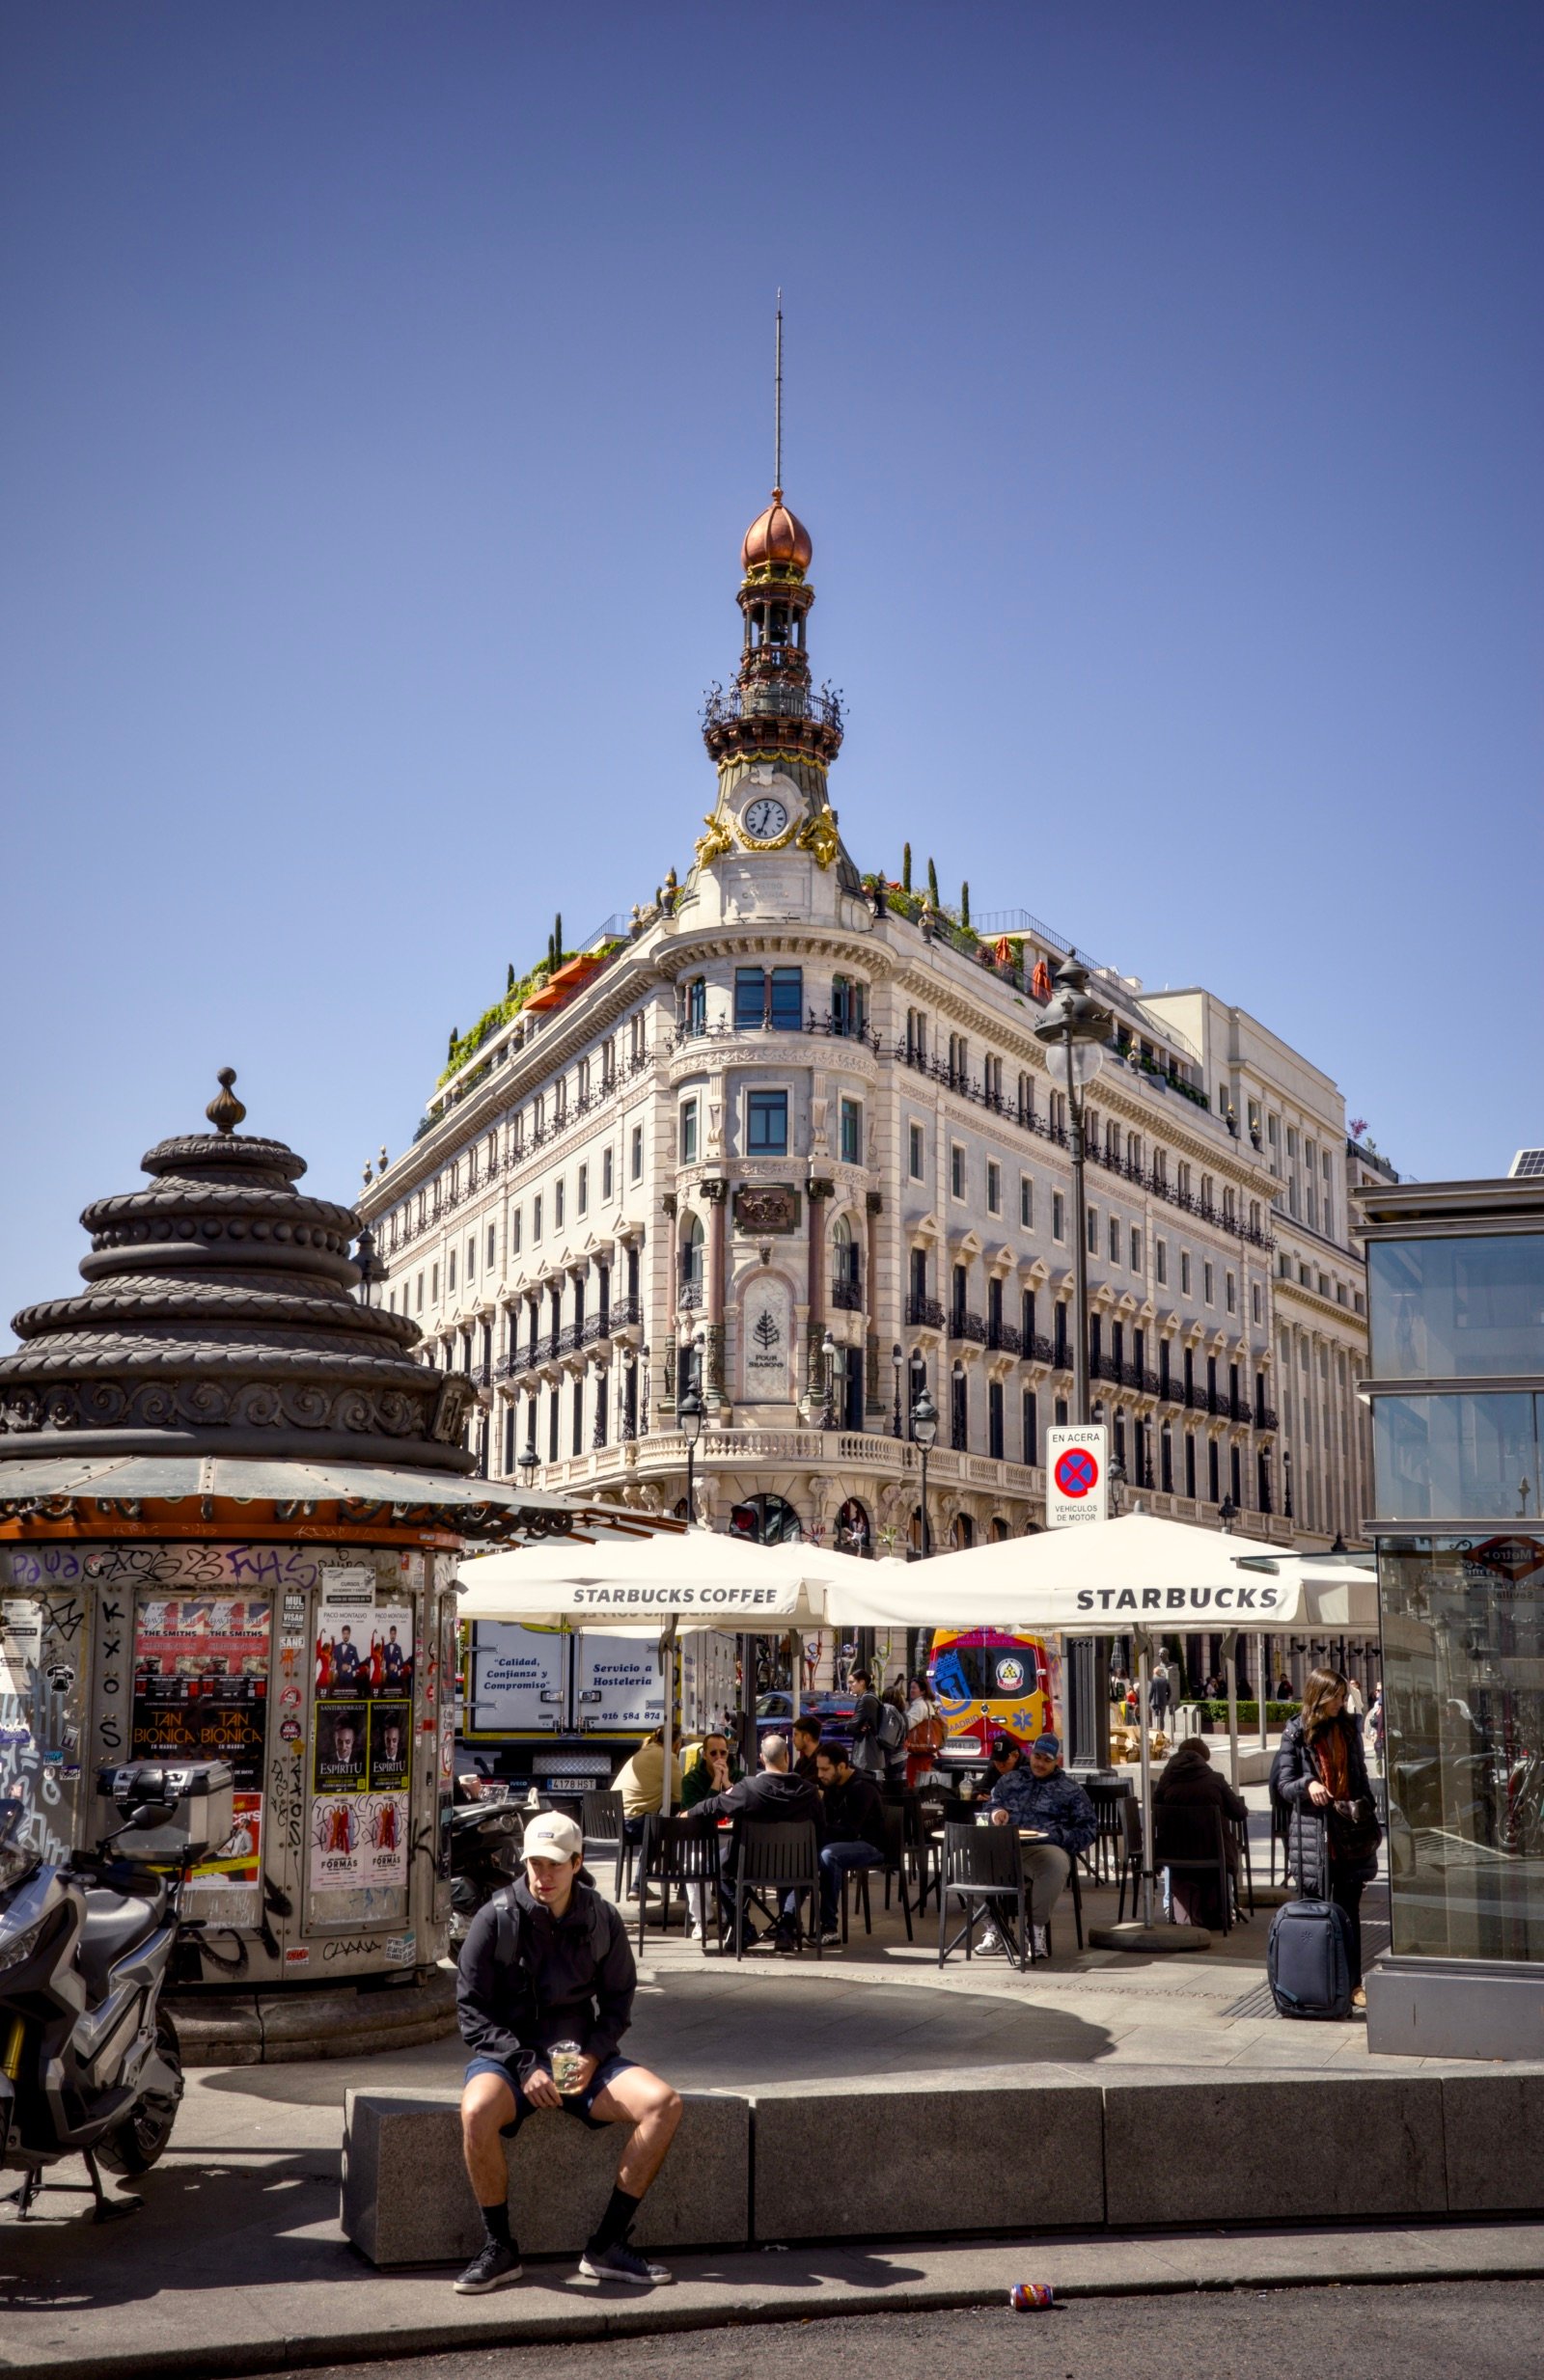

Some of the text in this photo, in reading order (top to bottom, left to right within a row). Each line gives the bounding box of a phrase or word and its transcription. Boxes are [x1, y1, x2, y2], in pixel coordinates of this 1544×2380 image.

[1052, 1433, 1100, 1442] EN ACERA
[1055, 1504, 1098, 1513] VEHÍCULOS
[573, 1588, 778, 1603] STARBUCKS COFFEE
[1076, 1587, 1279, 1611] STARBUCKS
[285, 1596, 305, 1606] MUL
[593, 1663, 640, 1673] Servicio
[486, 1670, 538, 1679] Confianza
[151, 1711, 182, 1727] TAN
[218, 1711, 250, 1727] TAN
[601, 1711, 619, 1720] 916
[622, 1711, 640, 1720] 584
[644, 1711, 660, 1720] 874
[134, 1728, 196, 1743] BIONICA
[201, 1728, 262, 1743] BIONICA
[553, 1779, 594, 1789] 4178 HST
[321, 1859, 358, 1869] FORMAS
[372, 1856, 400, 1866] FORMAS
